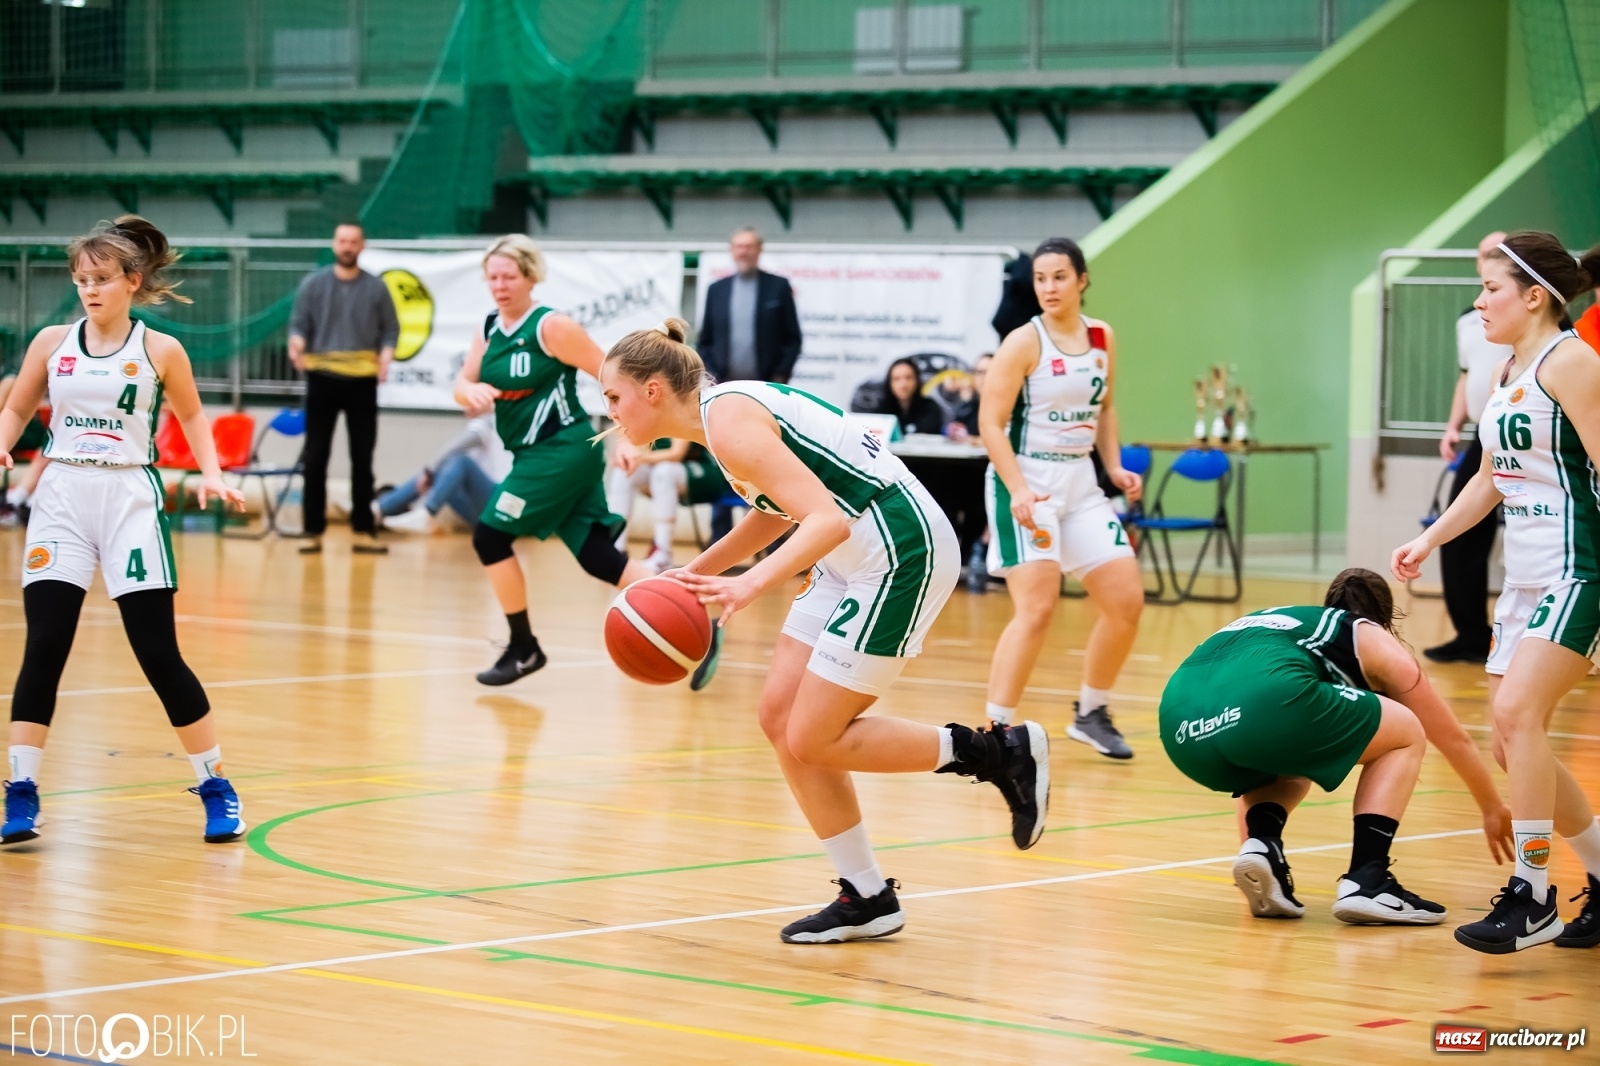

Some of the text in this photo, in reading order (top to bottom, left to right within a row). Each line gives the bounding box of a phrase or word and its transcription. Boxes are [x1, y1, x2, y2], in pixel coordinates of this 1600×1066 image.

[510, 351, 531, 378] 10
[117, 383, 138, 415] 4
[65, 415, 124, 430] OLIMPIA
[1497, 413, 1532, 451] 16
[126, 548, 147, 582] 4
[1188, 706, 1241, 738] Clavis
